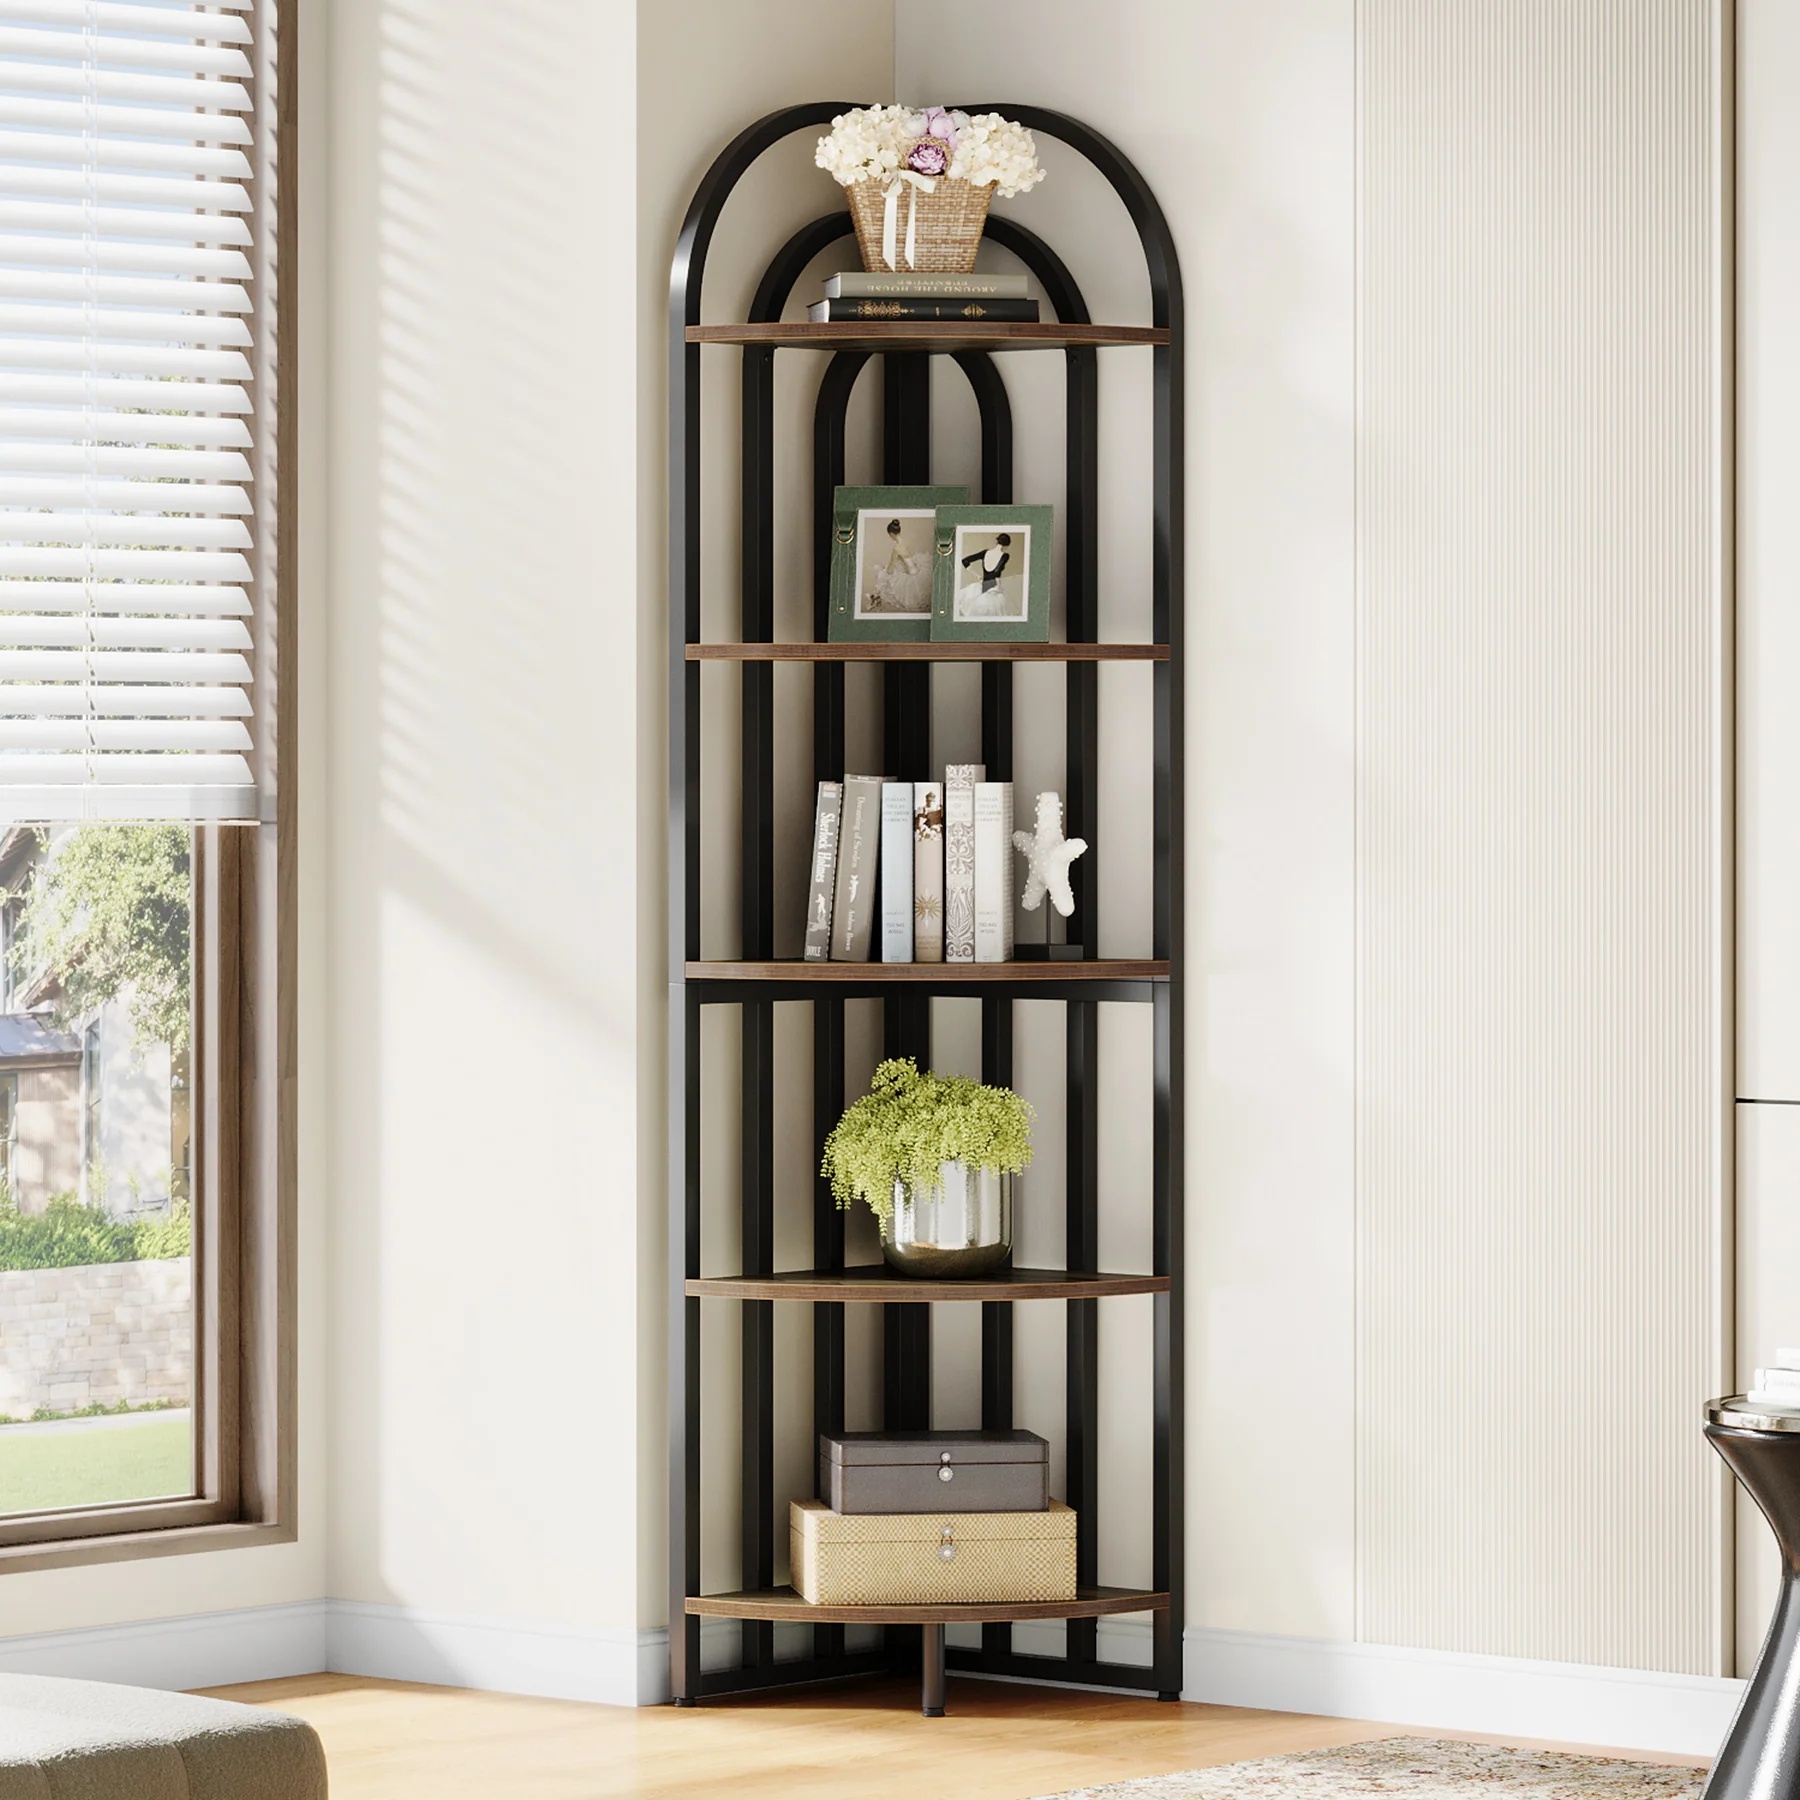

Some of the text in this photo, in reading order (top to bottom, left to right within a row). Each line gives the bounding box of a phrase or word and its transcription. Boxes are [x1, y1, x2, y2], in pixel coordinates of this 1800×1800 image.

[853, 796, 866, 831] Dreaming
[819, 812, 835, 849] Sherlock
[815, 852, 831, 882] Holmes
[851, 840, 861, 868] Sweden
[844, 908, 856, 951] Andrew Brown
[806, 945, 821, 957] DOYLE
